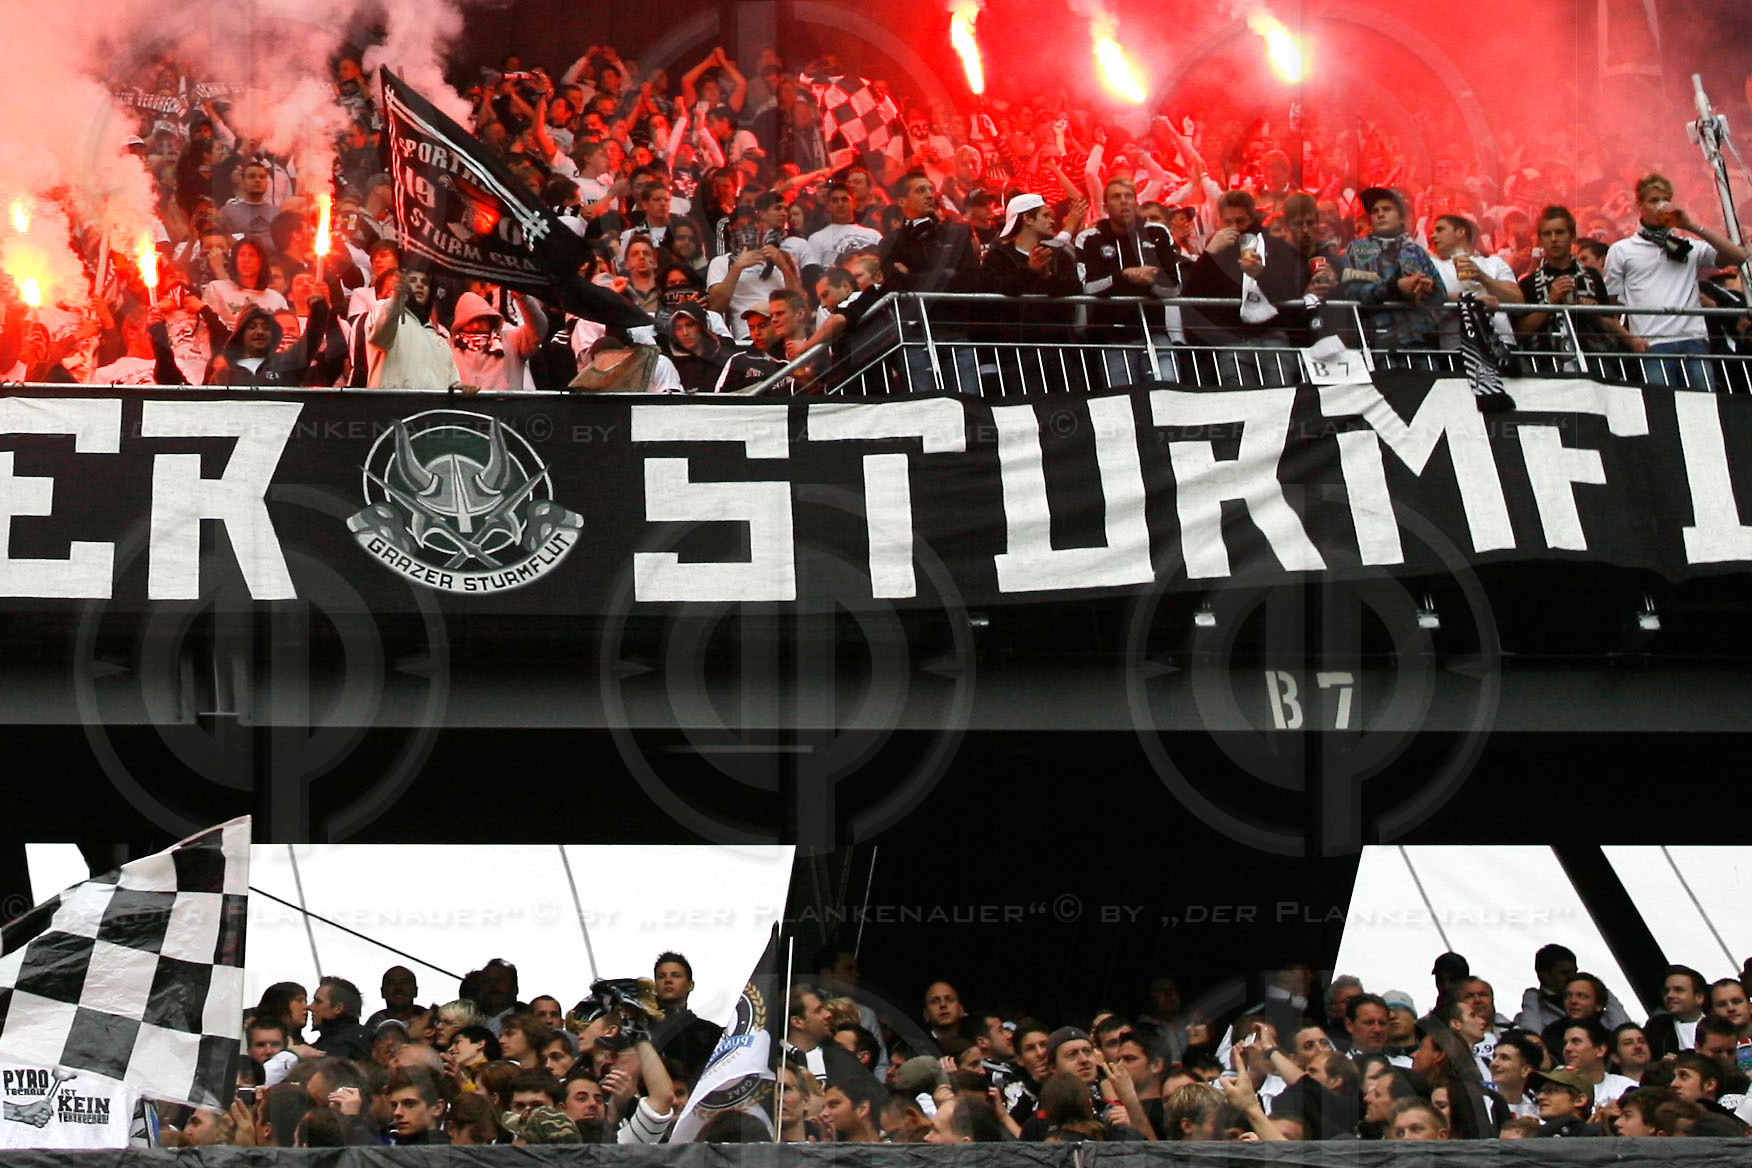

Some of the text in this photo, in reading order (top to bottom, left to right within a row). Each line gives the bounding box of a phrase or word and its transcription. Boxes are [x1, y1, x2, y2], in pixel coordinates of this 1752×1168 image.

[409, 207, 540, 272] STURM GRA
[1312, 362, 1349, 377] B 7
[367, 533, 571, 592] GRAZER STURMFLUT
[1265, 670, 1354, 730] B 7
[3, 1069, 49, 1090] PYRO
[57, 1095, 110, 1114] KEIN
